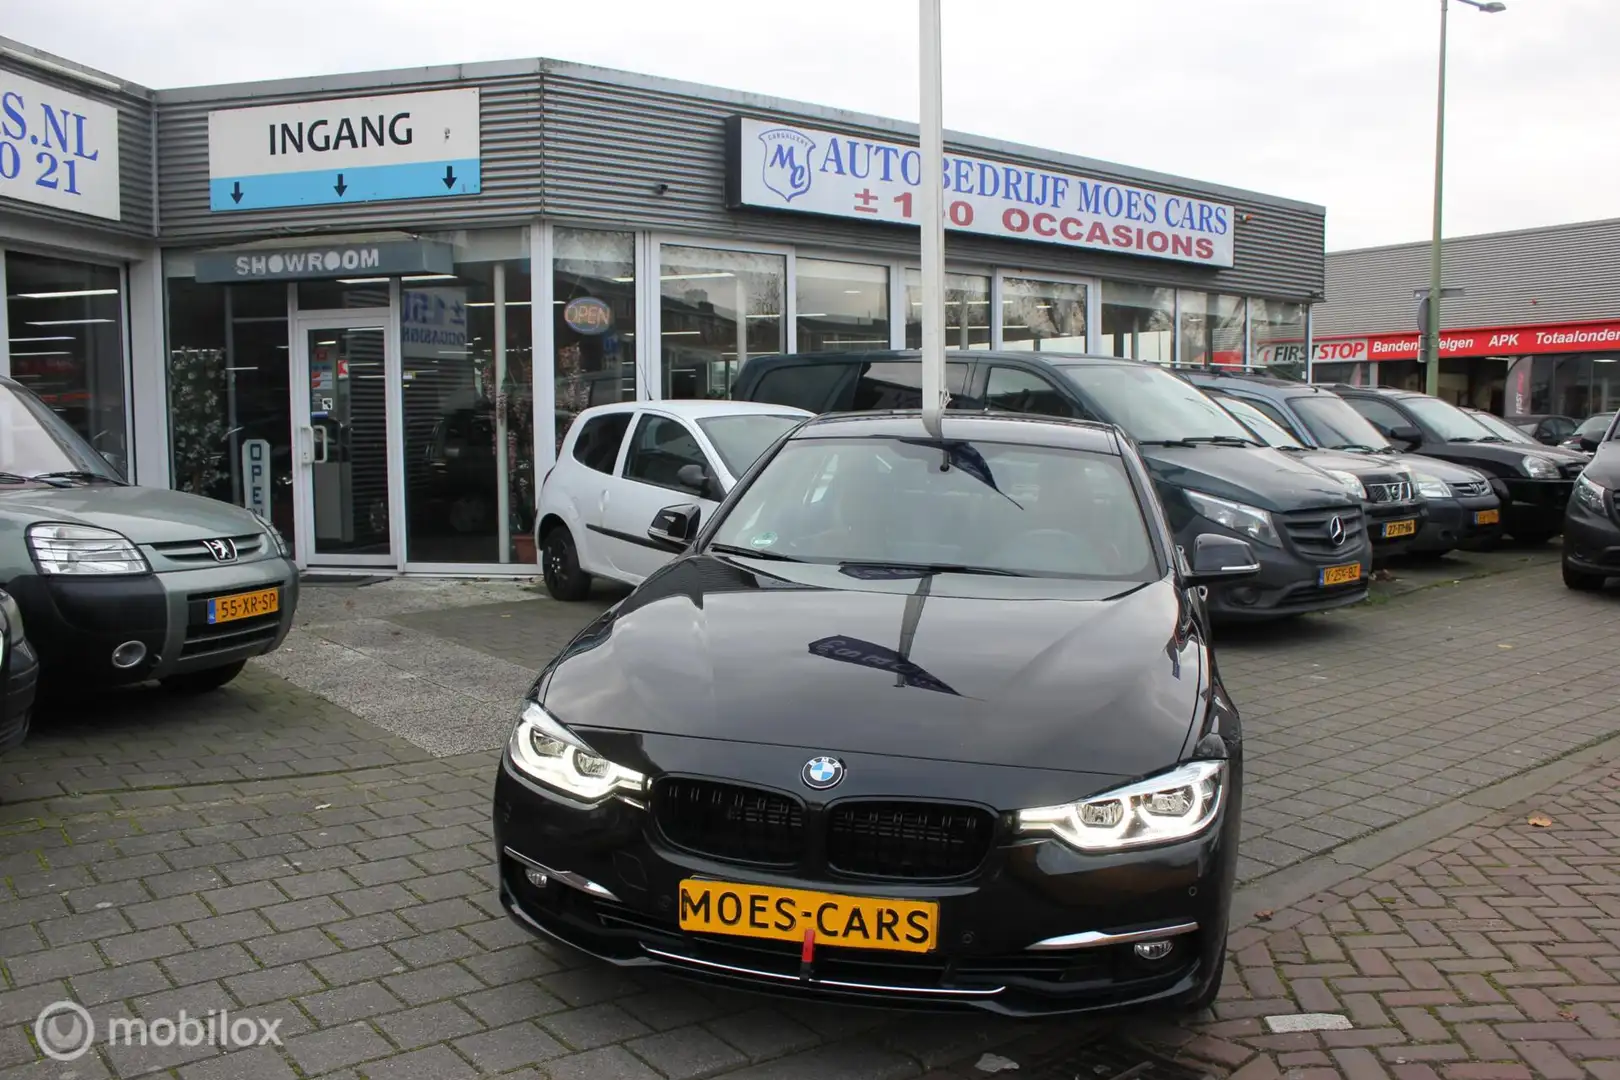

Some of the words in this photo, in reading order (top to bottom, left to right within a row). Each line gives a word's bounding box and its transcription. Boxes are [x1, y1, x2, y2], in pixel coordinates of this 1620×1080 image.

[269, 112, 413, 156] INGANG
[35, 151, 82, 196] 21
[893, 191, 974, 227] 10
[1001, 207, 1215, 260] OCCASIONS
[1077, 181, 1157, 224] MOES
[1164, 197, 1228, 236] CARS
[235, 248, 380, 276] SHOWROOM
[564, 304, 610, 326] OPEN
[1372, 340, 1418, 353] Banden
[1438, 338, 1474, 351] elgen
[1488, 334, 1520, 347] APK
[1535, 328, 1620, 345] Totaalonder
[221, 593, 276, 618] 55-XR-SP
[681, 889, 930, 945] MOES-CARS
